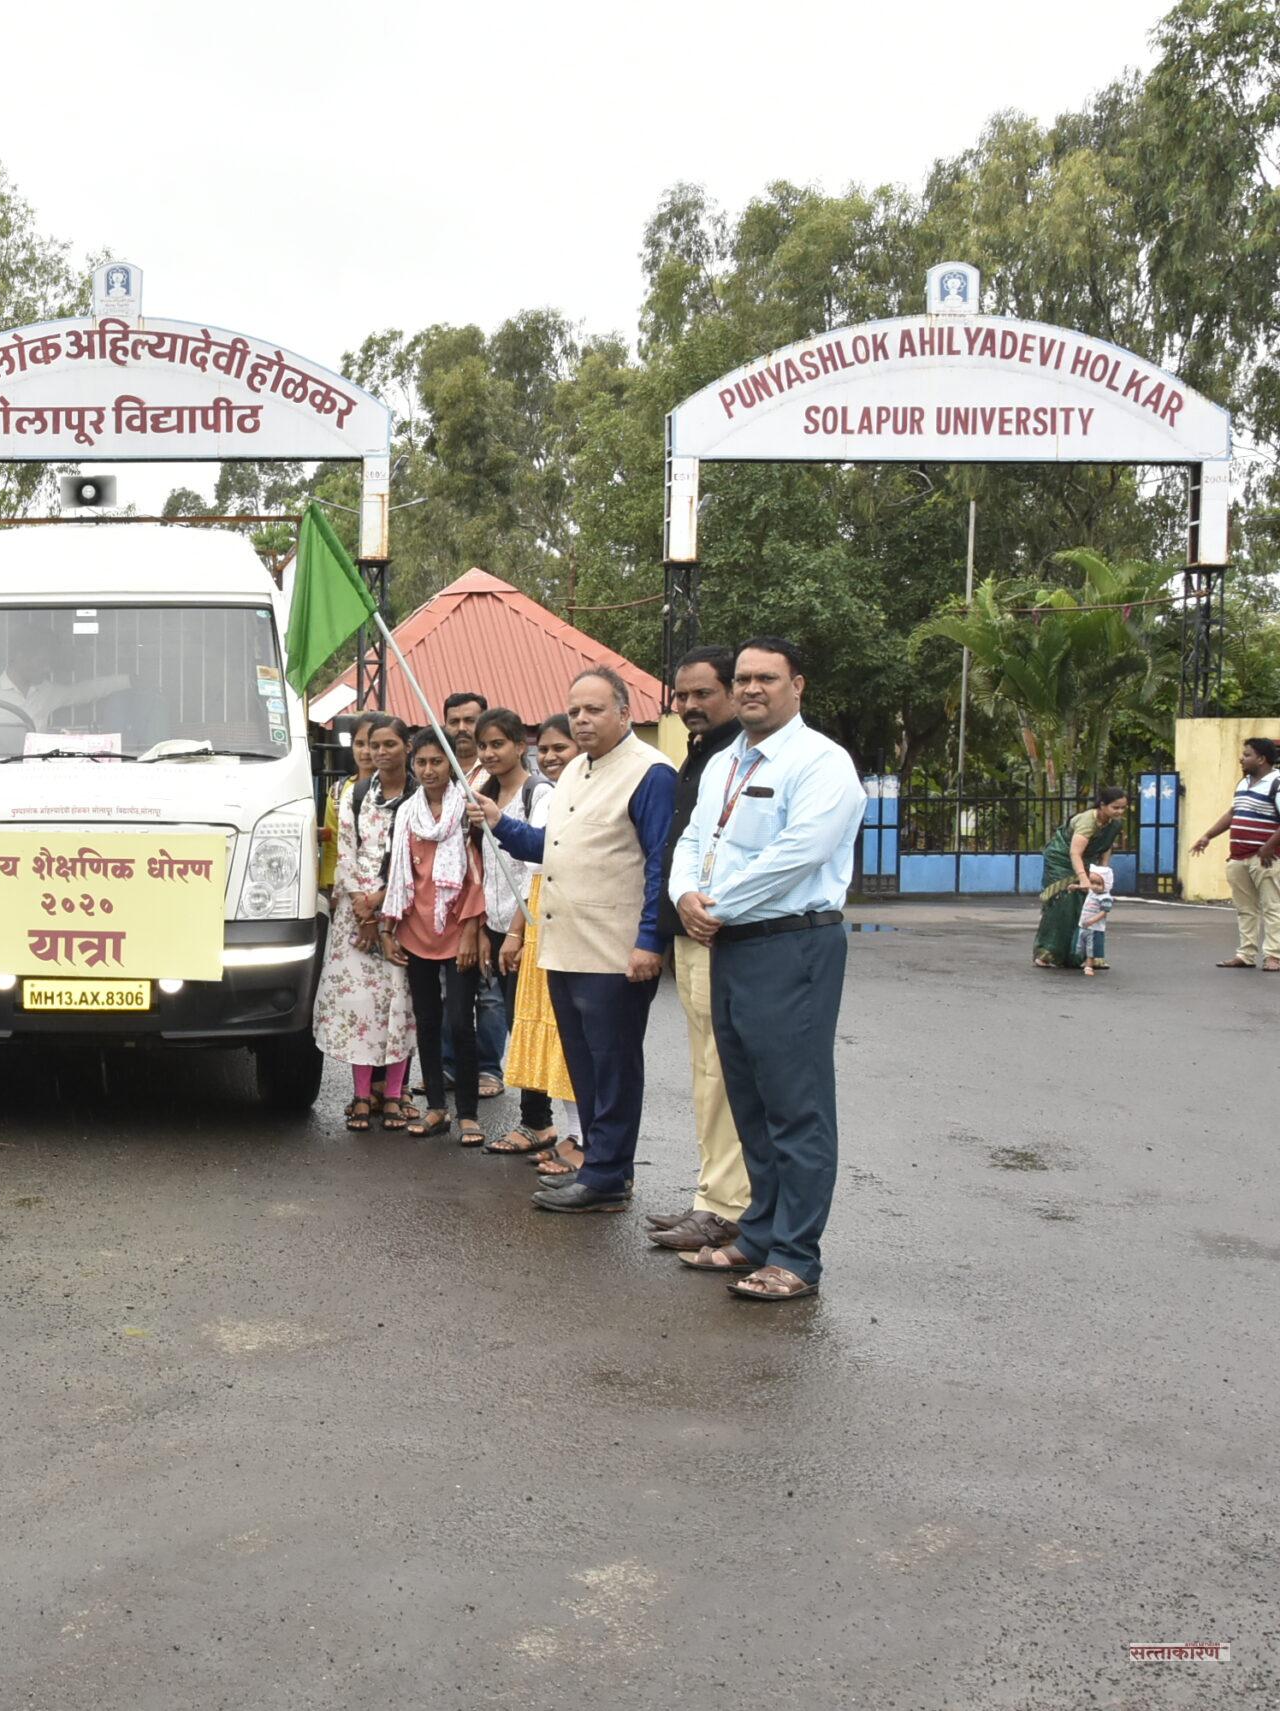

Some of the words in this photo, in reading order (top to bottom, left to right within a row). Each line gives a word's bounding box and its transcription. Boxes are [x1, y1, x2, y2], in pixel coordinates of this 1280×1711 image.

[65, 317, 251, 378] अहिल्यादेवी
[246, 350, 358, 430] होळकर
[718, 331, 890, 419] PUNYASHLOK
[898, 326, 1065, 369] AHILYADEVI
[1070, 347, 1185, 427] HOLKAR
[113, 394, 265, 434] विद्यापीठ
[803, 405, 925, 436] SOLAPUR
[935, 406, 1095, 436] UNIVERSITY
[32, 846, 136, 882] शैक्षणिक
[147, 848, 214, 882] धोरण
[40, 893, 115, 917] २०२०
[27, 929, 127, 968] यात्रा
[29, 990, 145, 1006] MH13.AX.8306
